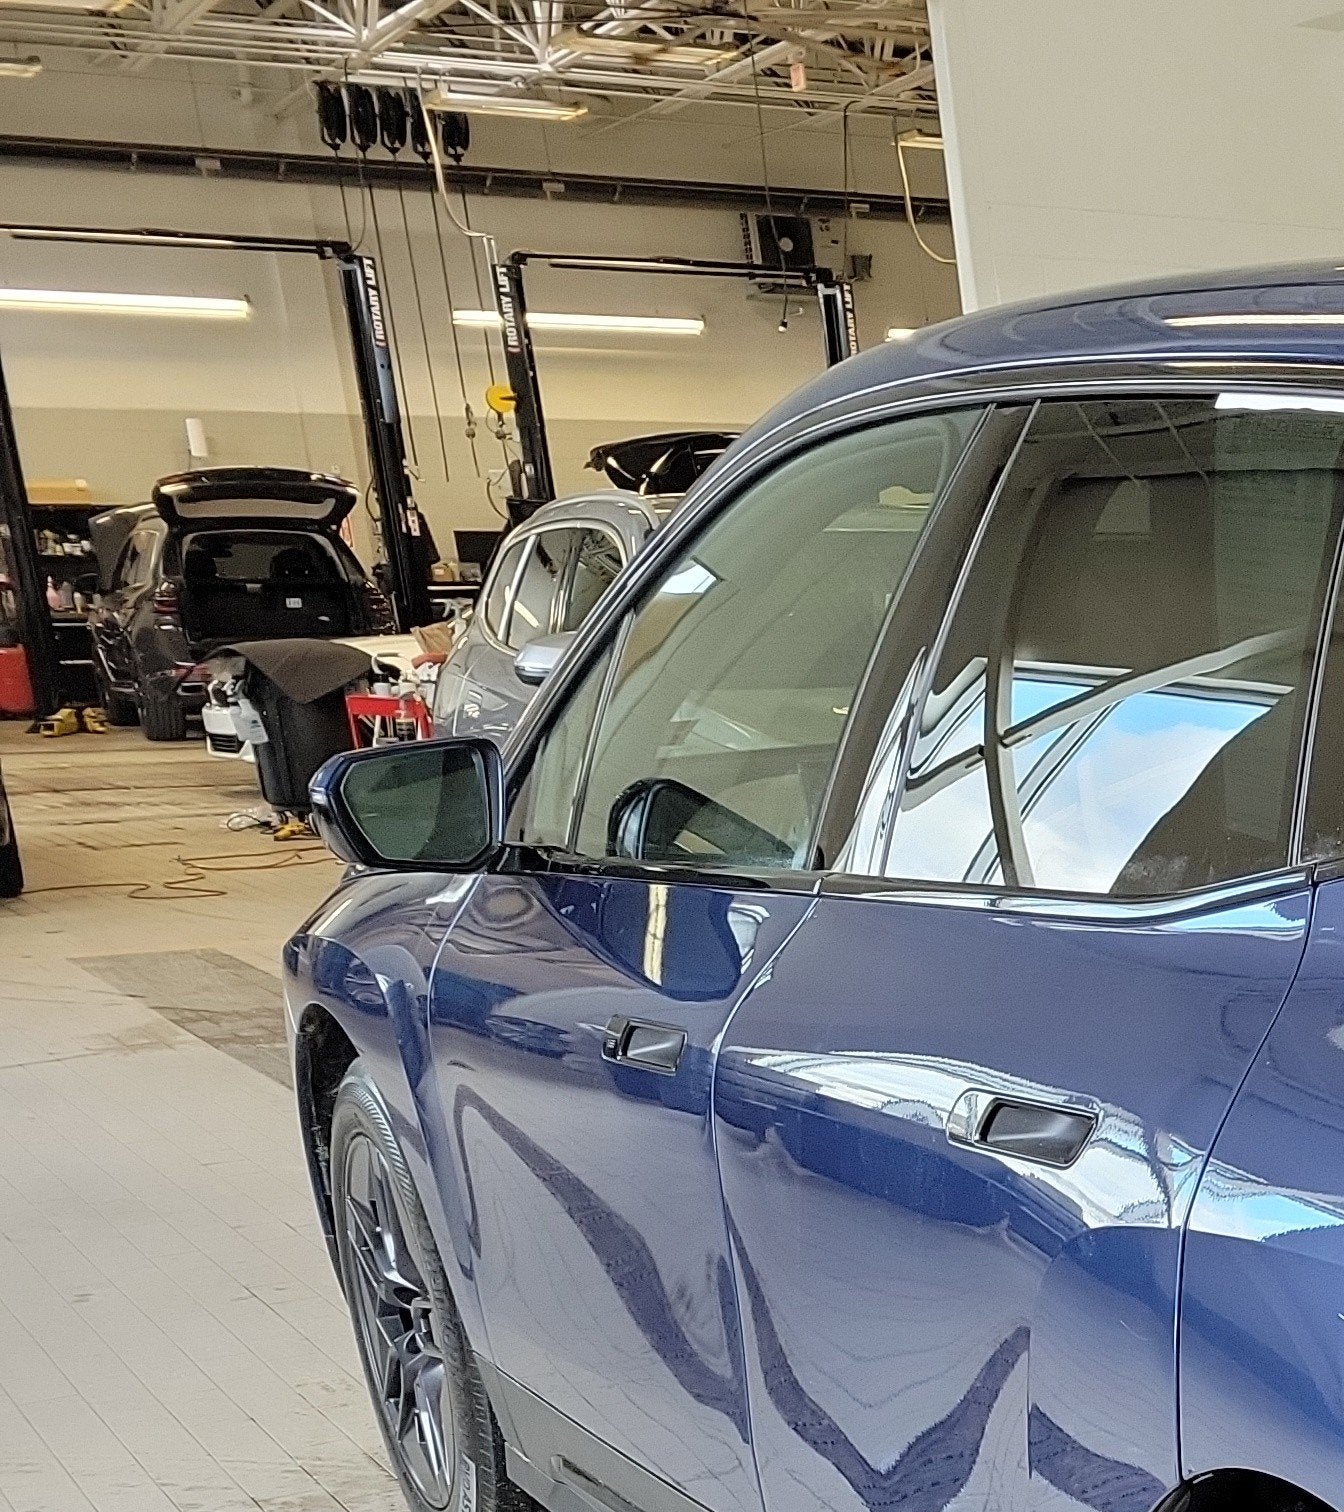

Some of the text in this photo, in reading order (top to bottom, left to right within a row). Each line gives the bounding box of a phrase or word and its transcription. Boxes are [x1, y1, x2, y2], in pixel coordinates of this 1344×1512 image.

[362, 257, 387, 341] ROTARY LIFT
[496, 265, 519, 346] ROTARY LIFT
[843, 283, 853, 309] LIFT
